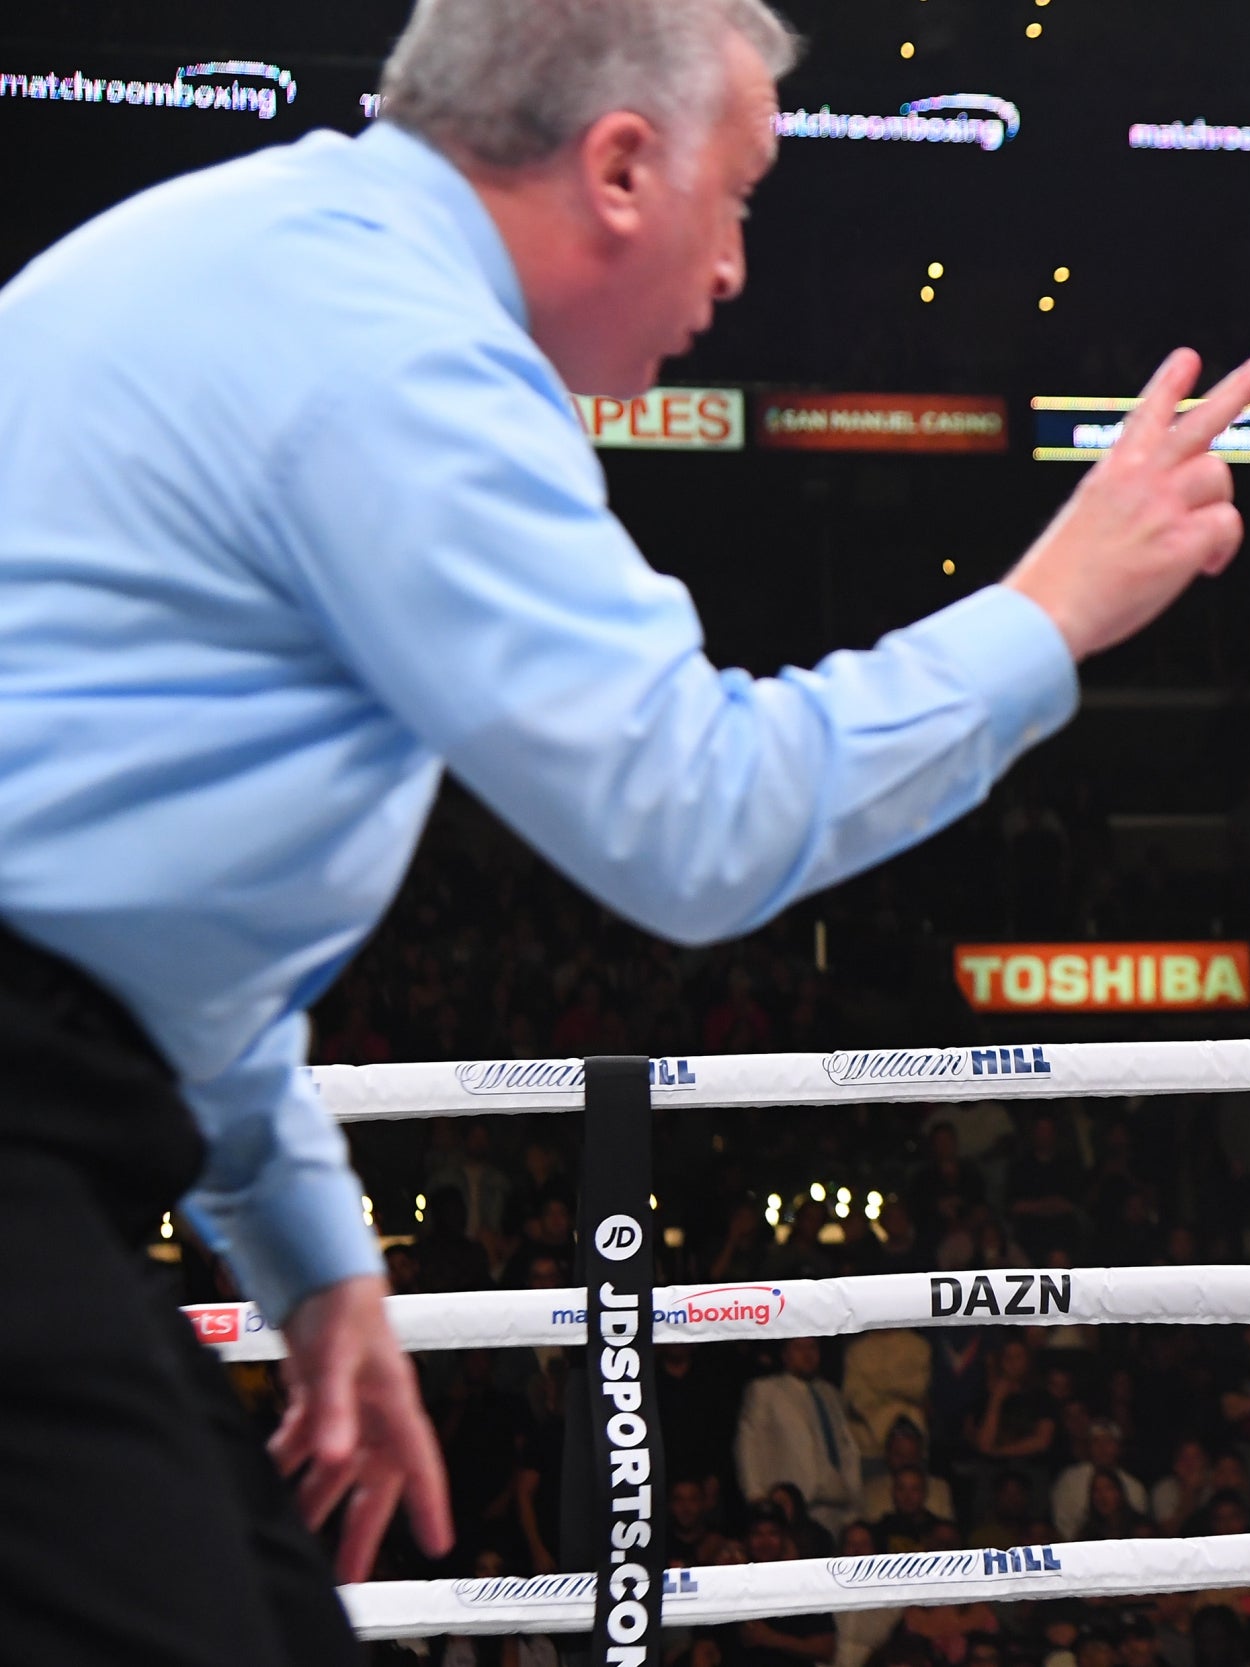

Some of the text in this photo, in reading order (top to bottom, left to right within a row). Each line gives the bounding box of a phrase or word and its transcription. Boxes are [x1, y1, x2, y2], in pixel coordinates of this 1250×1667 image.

[962, 955, 1246, 1004] TOSHIBA
[822, 1046, 1051, 1085] William HILL
[602, 1226, 636, 1248] JD
[930, 1274, 1071, 1317] DAZN
[826, 1544, 1062, 1586] William HILL
